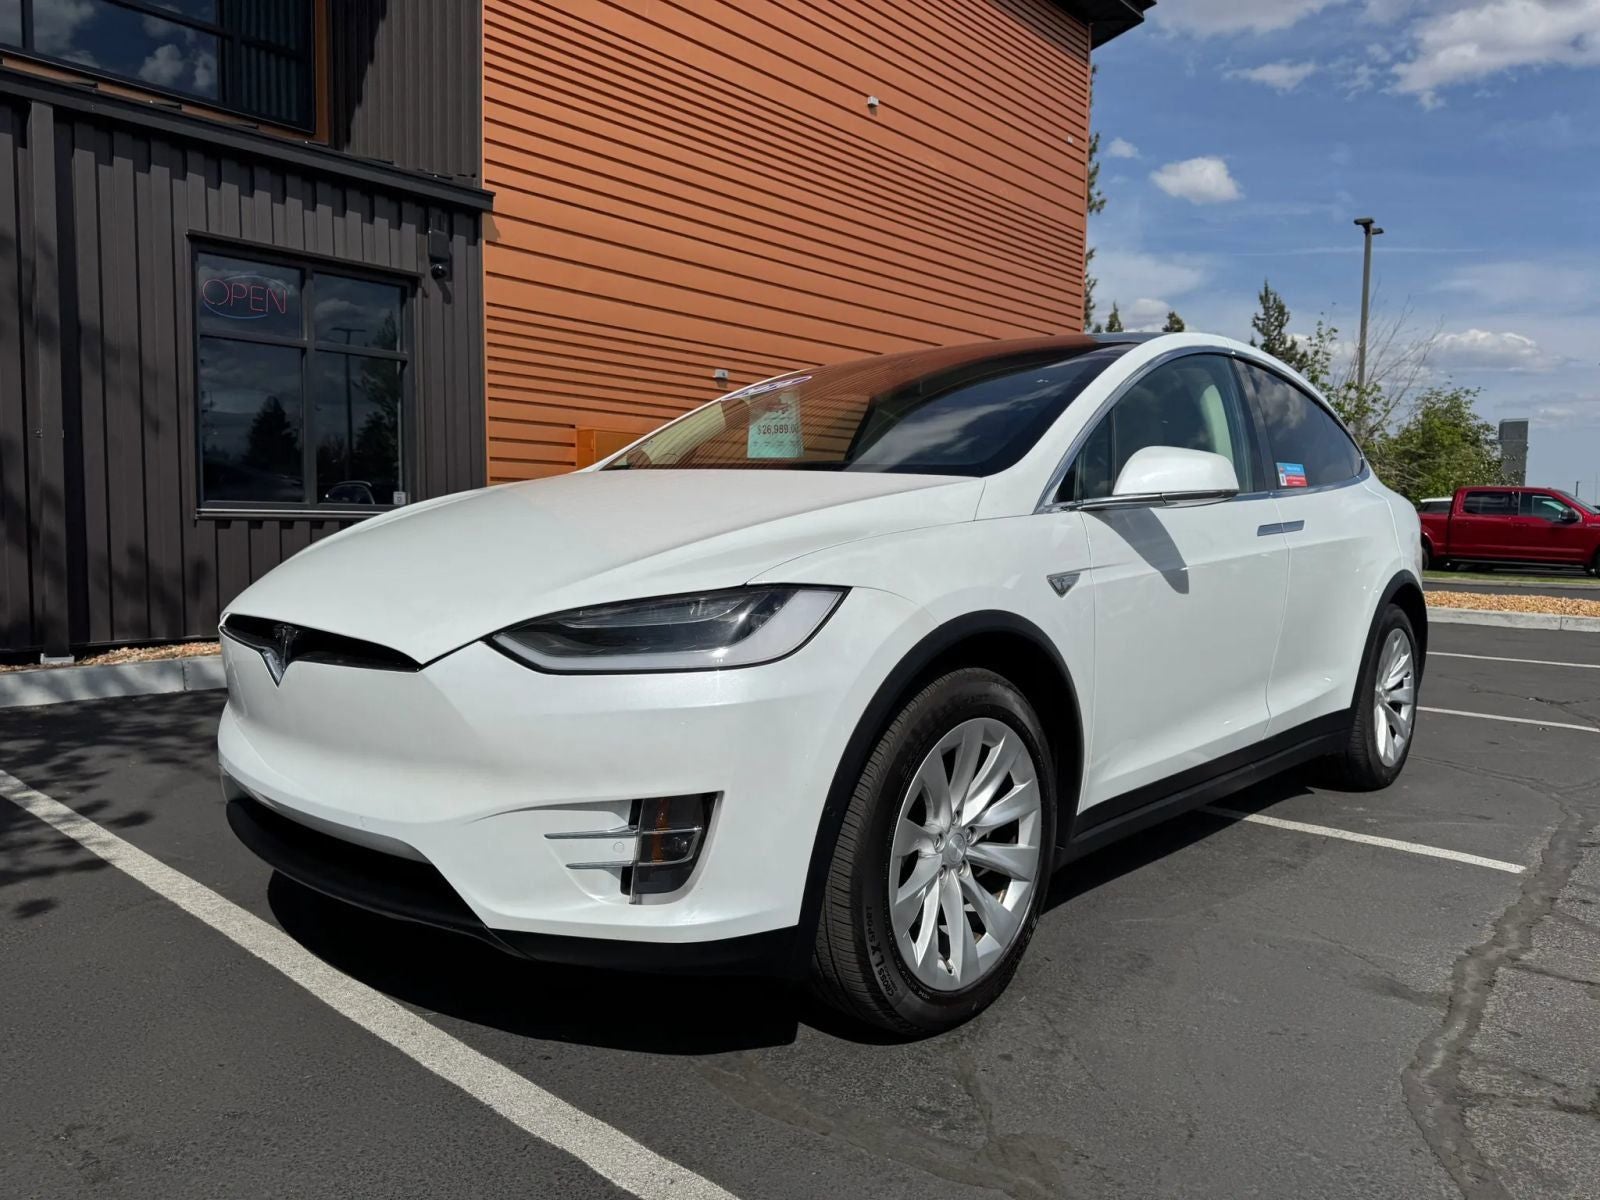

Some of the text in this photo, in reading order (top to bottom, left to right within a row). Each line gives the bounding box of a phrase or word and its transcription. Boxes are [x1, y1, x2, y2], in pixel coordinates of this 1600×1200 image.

[202, 279, 287, 314] OPEN
[866, 905, 876, 943] SPORT
[878, 968, 894, 997] CROSS
